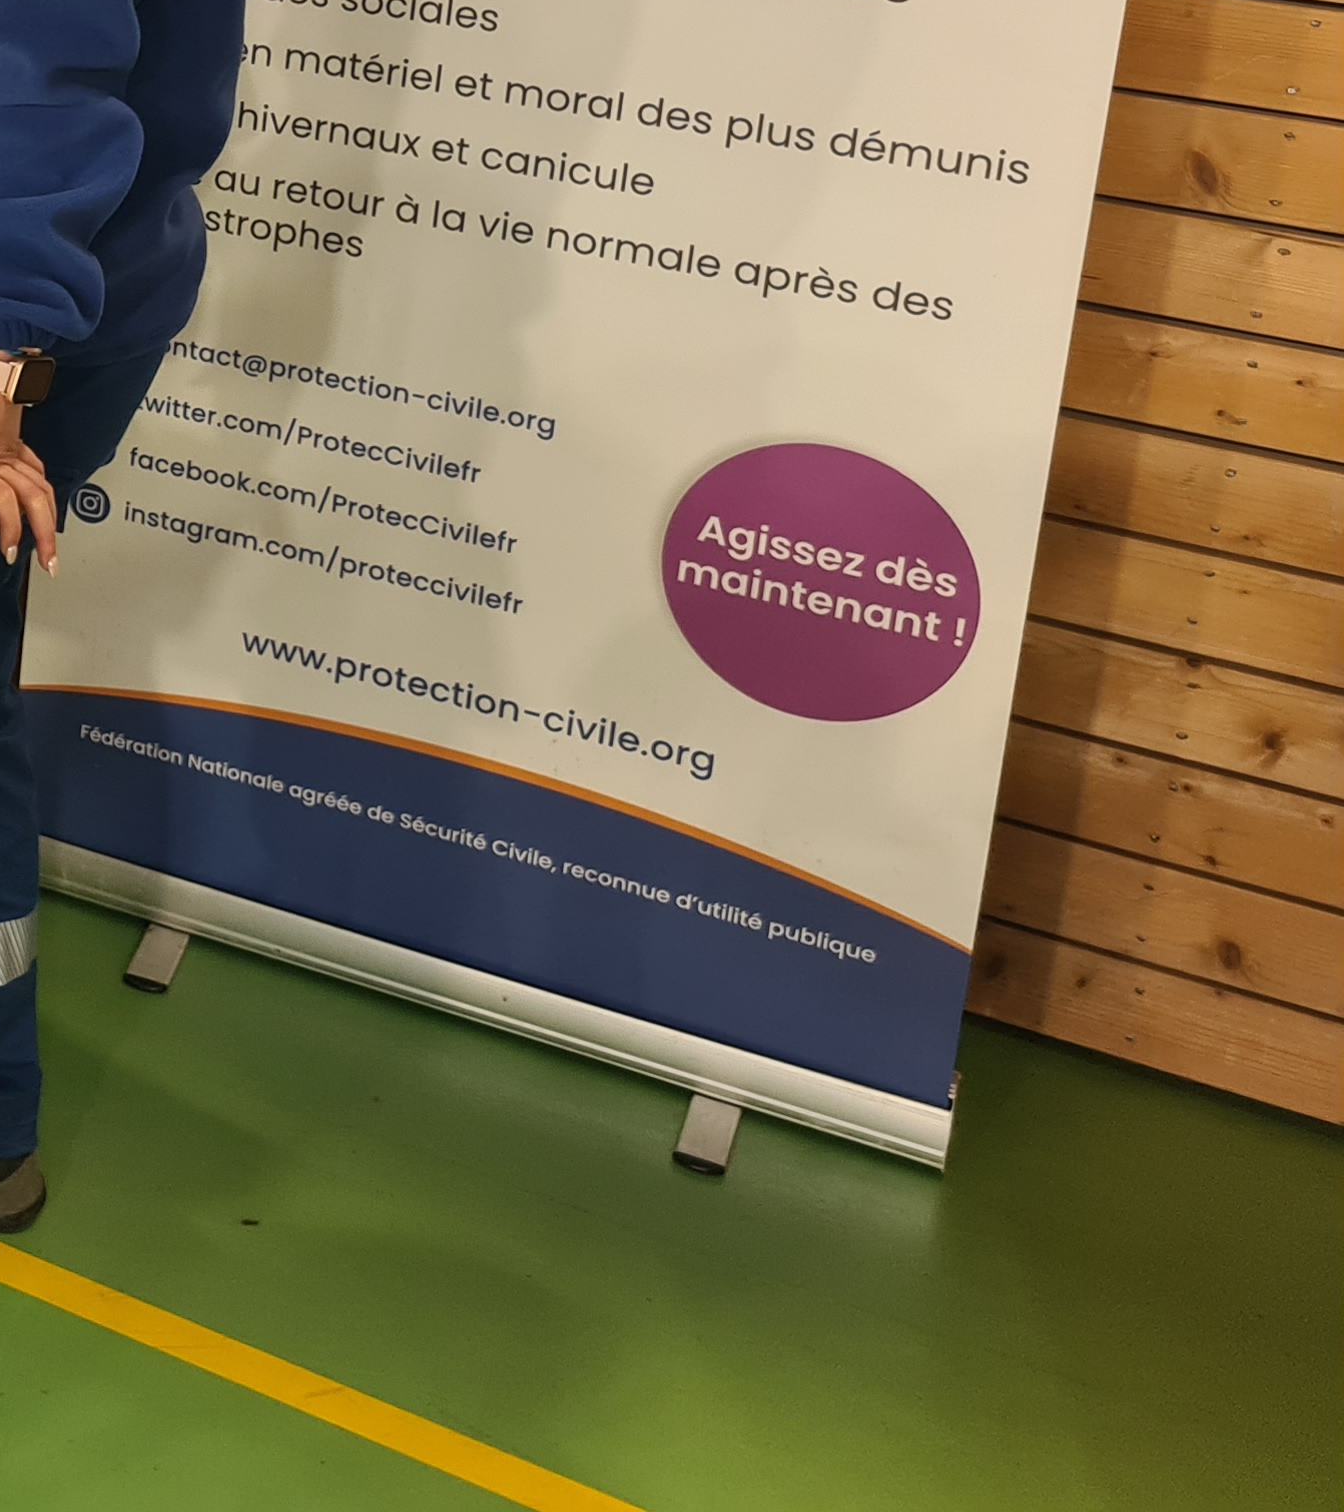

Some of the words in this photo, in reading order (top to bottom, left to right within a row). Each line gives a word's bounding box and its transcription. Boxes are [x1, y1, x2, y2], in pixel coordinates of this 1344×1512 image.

[238, 101, 421, 158] hivernaux
[432, 138, 470, 165] et
[481, 148, 654, 195] canicule
[285, 48, 442, 93] matériel
[455, 73, 493, 101] et
[505, 81, 624, 121] moral
[637, 97, 712, 134] des
[725, 113, 815, 151] plus
[830, 128, 1029, 184] démunis
[215, 170, 260, 196] au
[273, 179, 385, 217] retour
[396, 193, 419, 224] à
[432, 200, 466, 233] la
[479, 211, 533, 244] vie
[547, 227, 720, 277] normale
[734, 262, 858, 303] après
[872, 281, 953, 320] des
[130, 447, 517, 553] facebook.com/ProtecCivilefr
[697, 516, 865, 577] Agissez
[876, 556, 958, 597] dès
[124, 501, 523, 614] instagram.com/proteccivilefr
[678, 560, 942, 641] maintenant
[242, 632, 714, 781] www.protection-civile.org
[81, 725, 183, 765] Fédération
[188, 754, 285, 793] Nationale
[289, 785, 362, 815] agréée
[367, 805, 395, 824] de
[400, 813, 487, 850] Sécurité
[492, 840, 556, 873] Civile,
[563, 862, 670, 903] reconnue
[676, 894, 762, 930] d'utilité
[768, 922, 876, 963] publique
